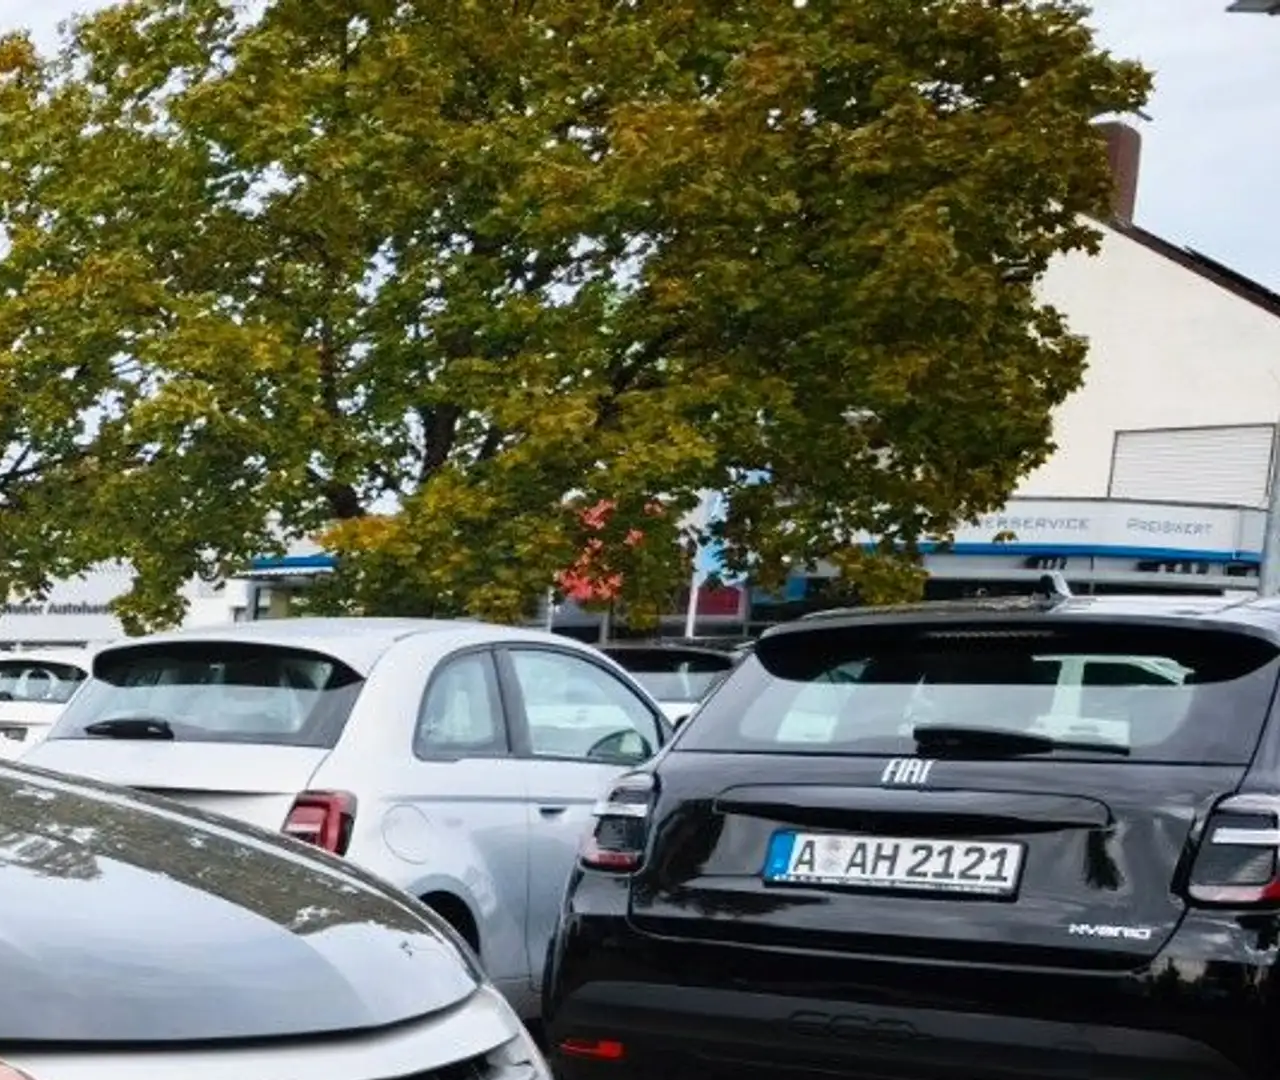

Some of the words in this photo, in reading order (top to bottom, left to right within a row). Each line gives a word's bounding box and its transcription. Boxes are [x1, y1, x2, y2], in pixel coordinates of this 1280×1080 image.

[881, 758, 935, 783] FIAT
[794, 840, 816, 873] A
[845, 841, 901, 876] AH
[906, 844, 1009, 883] 2121
